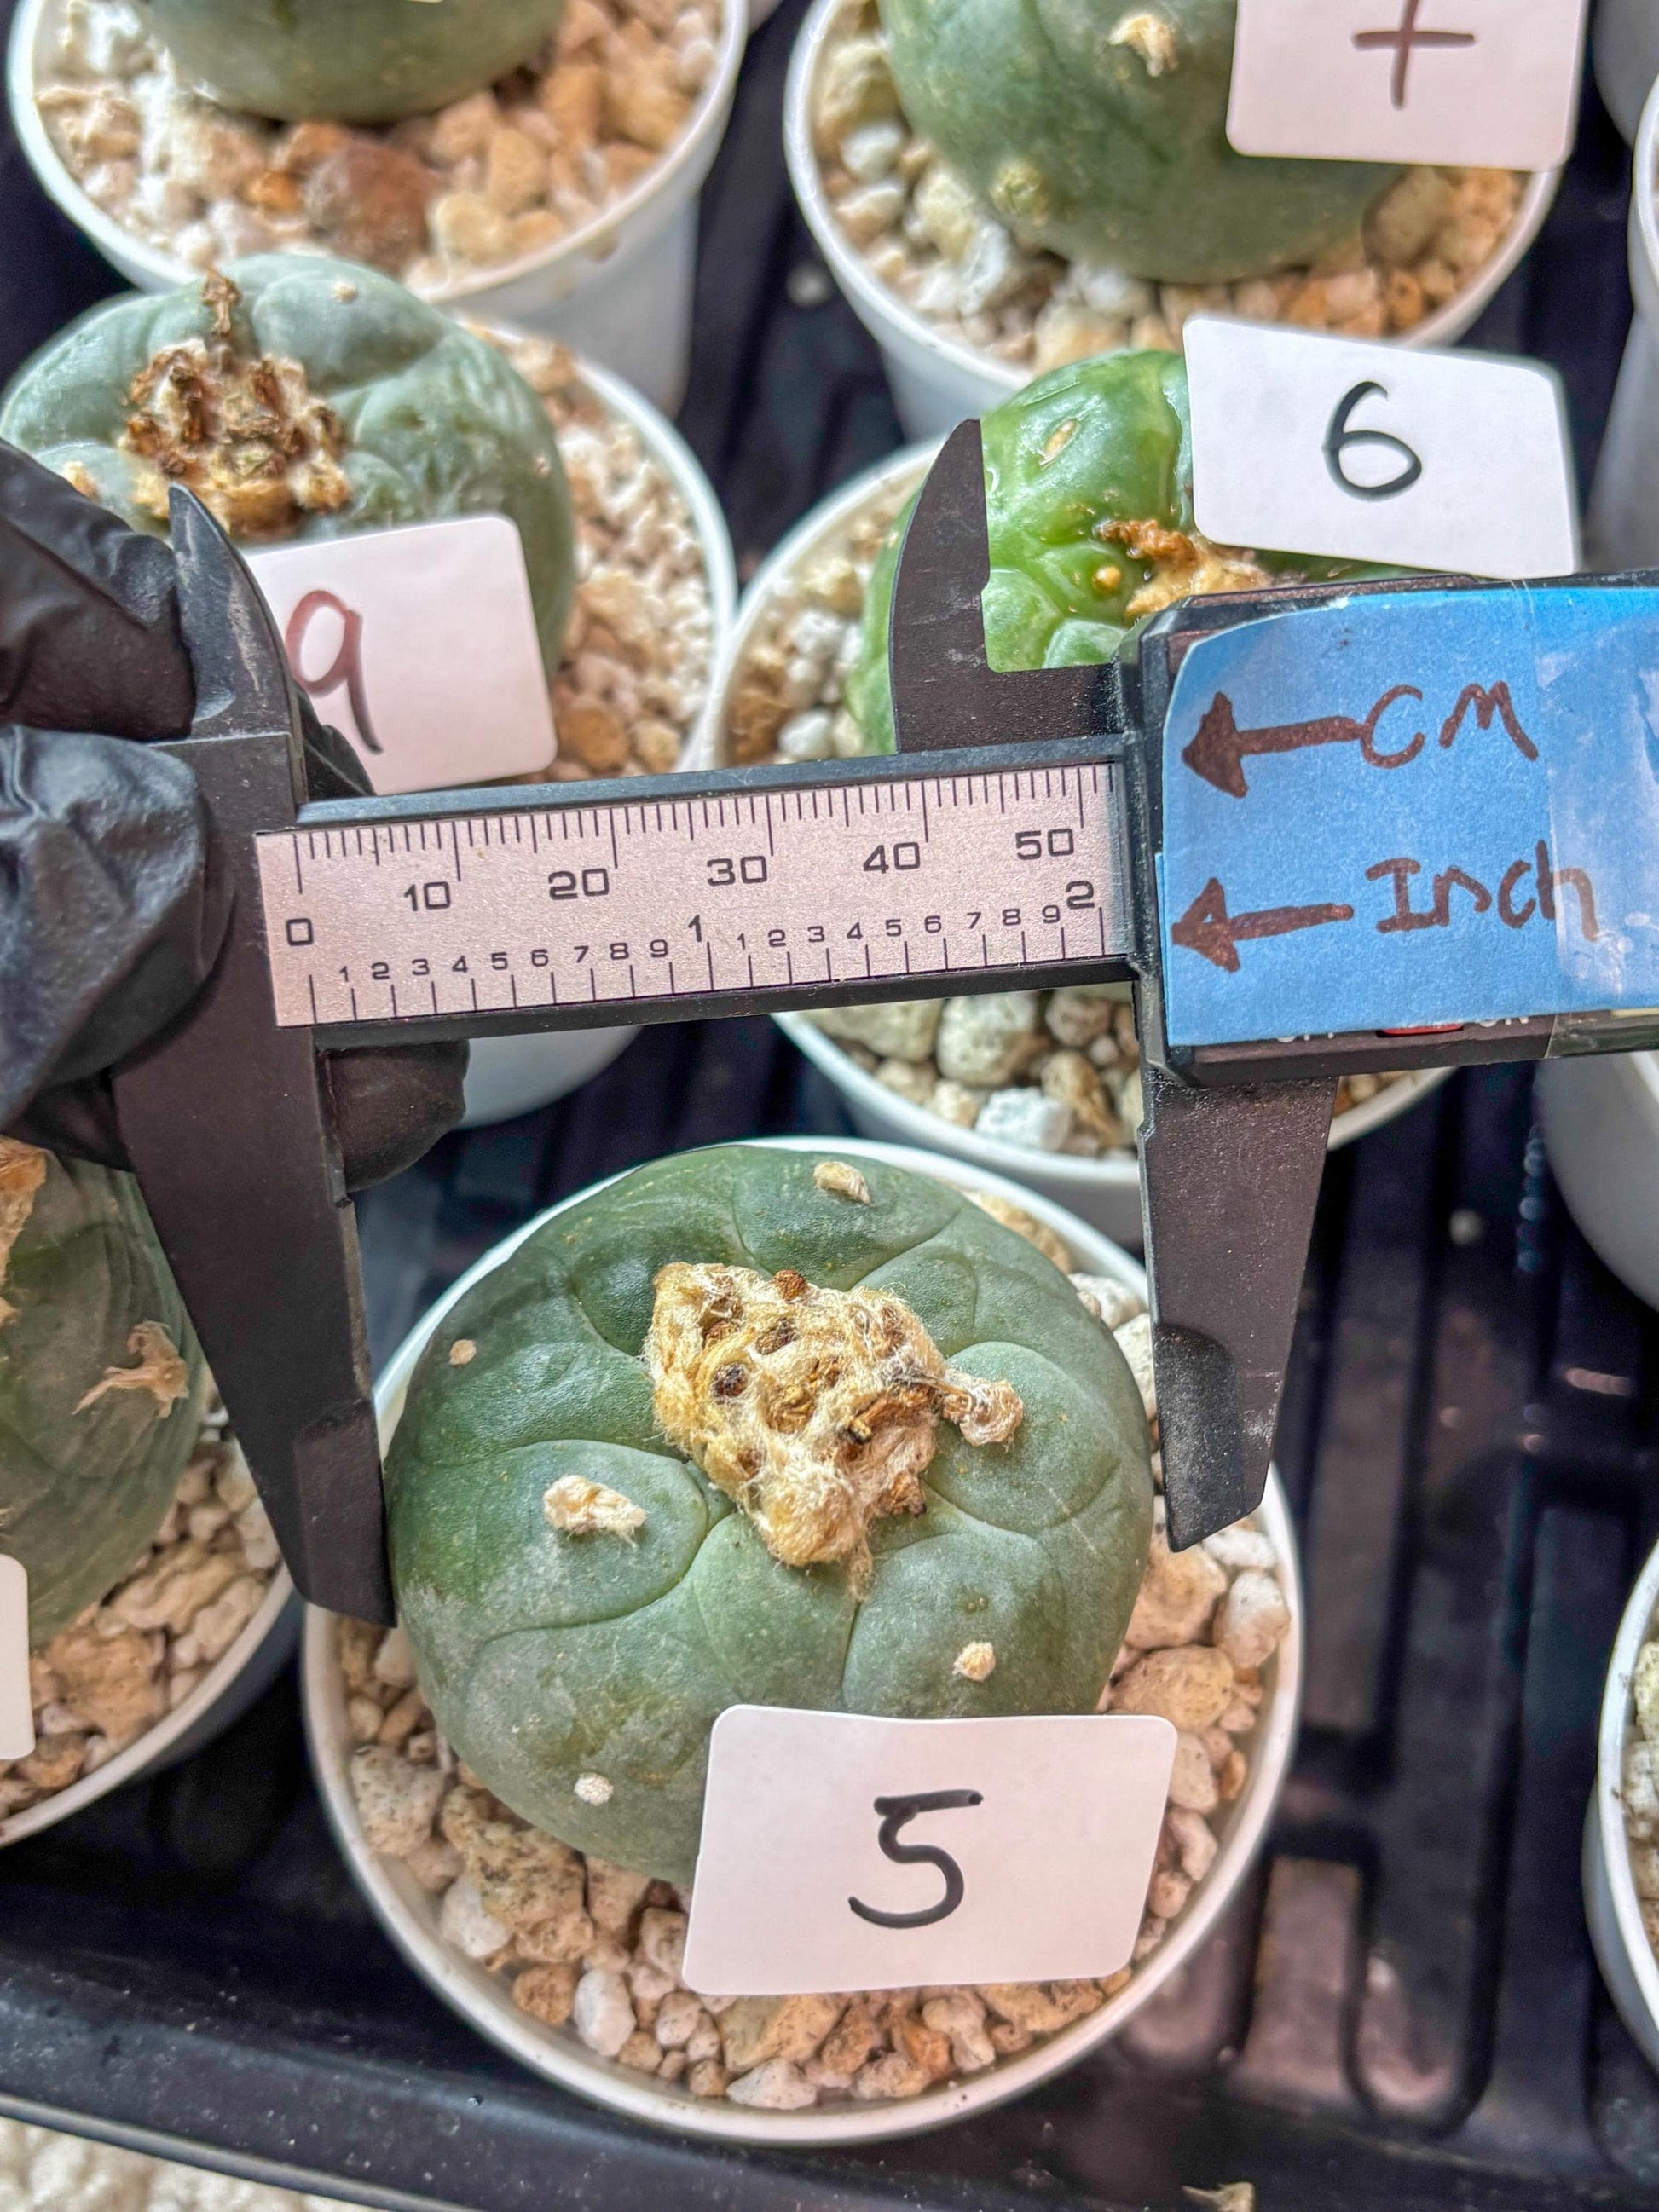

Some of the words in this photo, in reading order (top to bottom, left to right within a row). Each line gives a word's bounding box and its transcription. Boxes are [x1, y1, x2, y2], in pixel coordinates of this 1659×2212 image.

[1321, 381, 1422, 502] 6
[285, 590, 384, 754] 9
[403, 881, 451, 912] 10
[548, 868, 610, 900] 20
[707, 855, 767, 886] 30
[863, 841, 921, 874] 40
[1015, 828, 1074, 860] 50
[1366, 840, 1598, 942] Inch
[286, 918, 314, 946] 0
[338, 967, 349, 982] 1
[371, 962, 390, 979] 2
[411, 959, 429, 976] 3
[452, 956, 468, 973] 4
[492, 952, 507, 971] 5
[530, 949, 549, 967] 6
[574, 946, 589, 963] 7
[610, 943, 628, 960] 8
[650, 939, 668, 957] 9
[688, 915, 702, 942] 1
[737, 933, 745, 950] 1
[768, 929, 786, 947] 2
[807, 926, 825, 942] 3
[847, 922, 863, 940] 4
[886, 919, 902, 936] 5
[924, 915, 941, 933] 6
[966, 912, 982, 929] 7
[1002, 908, 1021, 925] 8
[1042, 905, 1061, 923] 9
[1066, 881, 1095, 910] 2
[847, 1789, 985, 1929] 5
